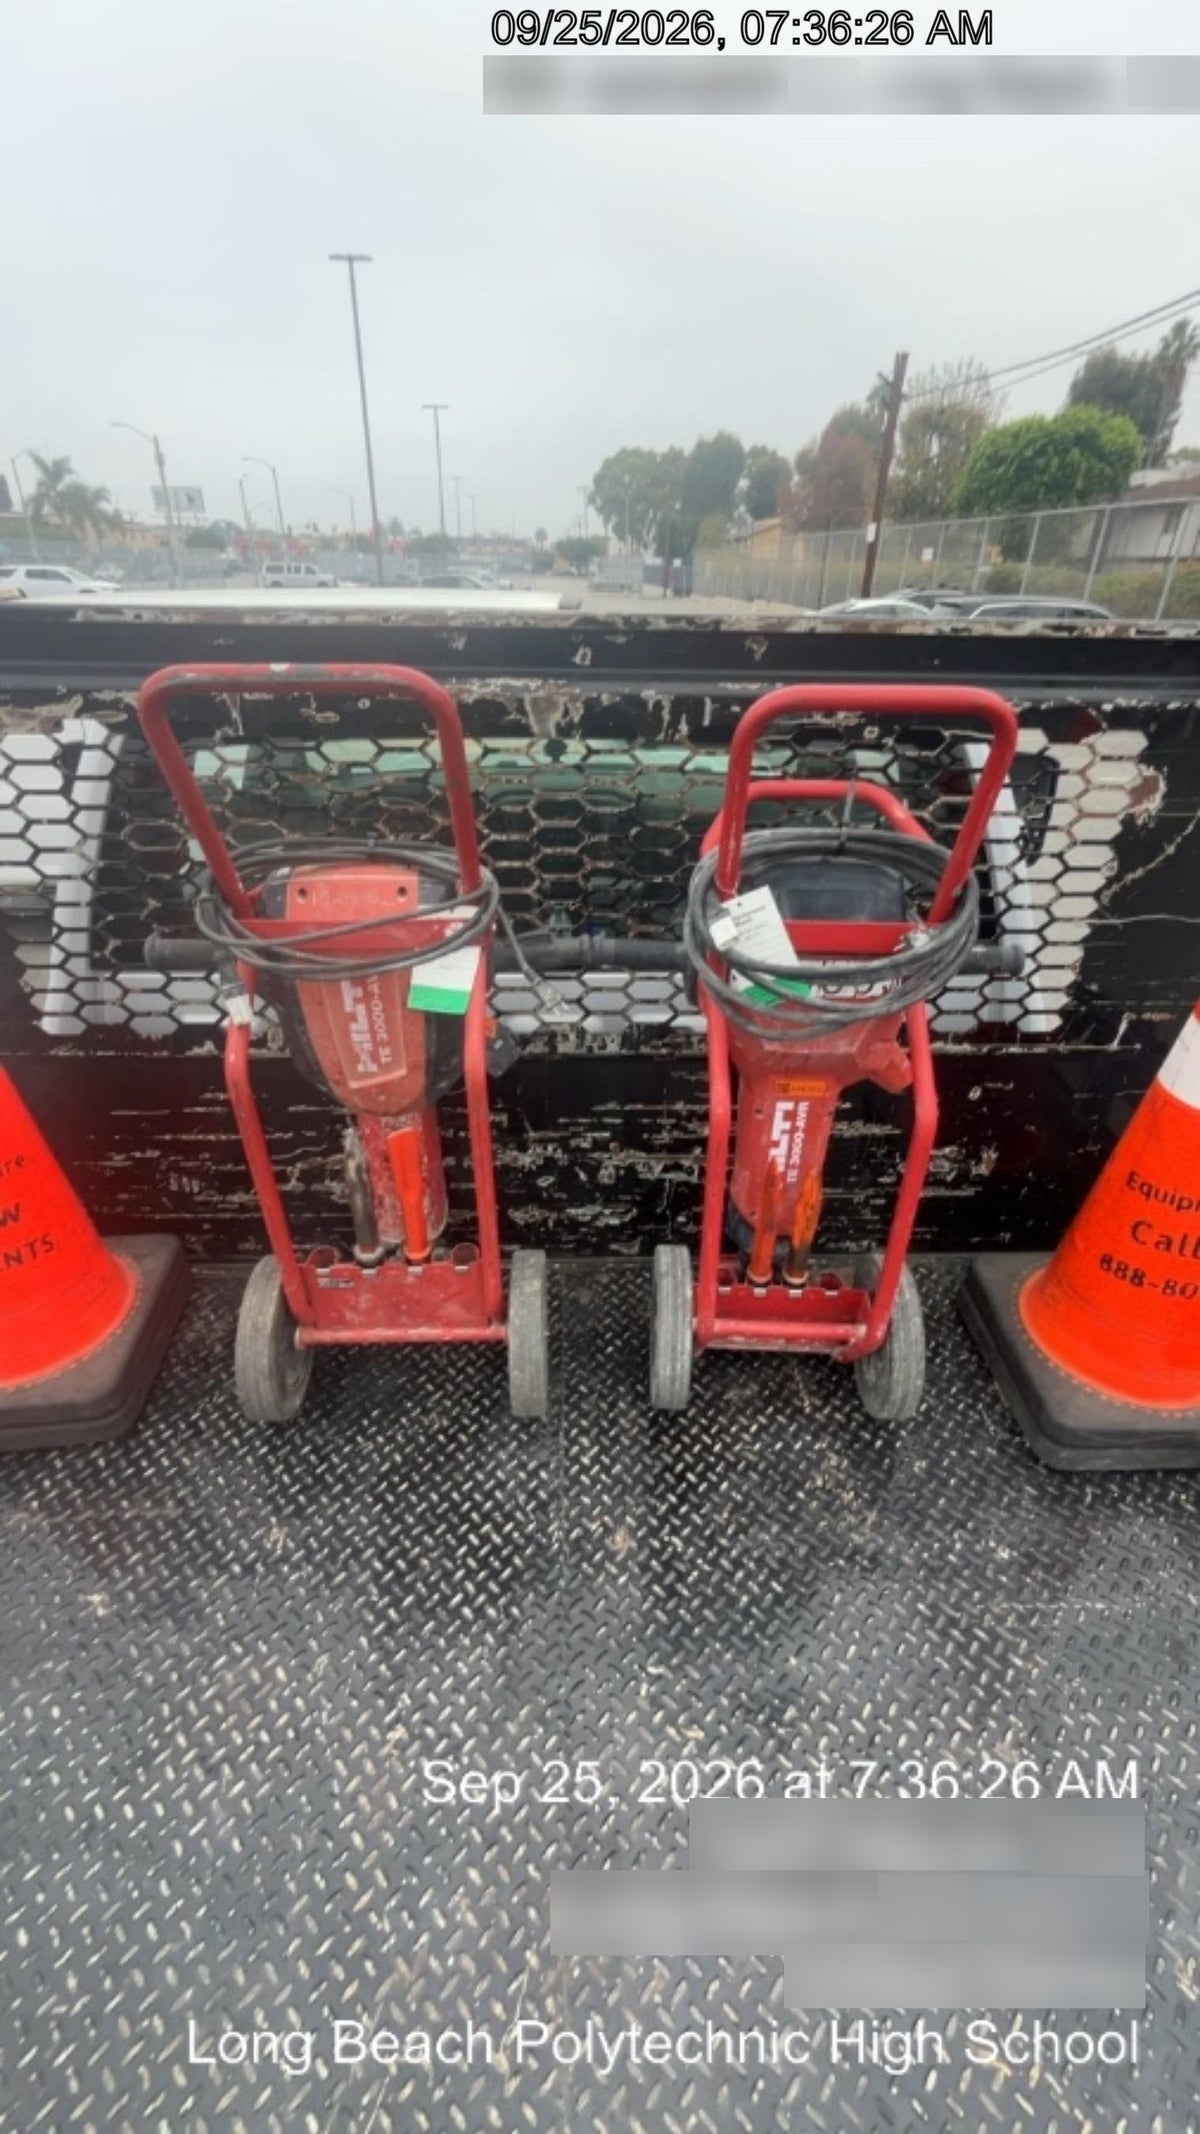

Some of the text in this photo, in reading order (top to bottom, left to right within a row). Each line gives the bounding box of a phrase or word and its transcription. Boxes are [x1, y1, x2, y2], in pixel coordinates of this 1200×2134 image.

[341, 980, 378, 1073] HILT
[768, 1101, 795, 1174] ILTI
[0, 1232, 55, 1271] NTS
